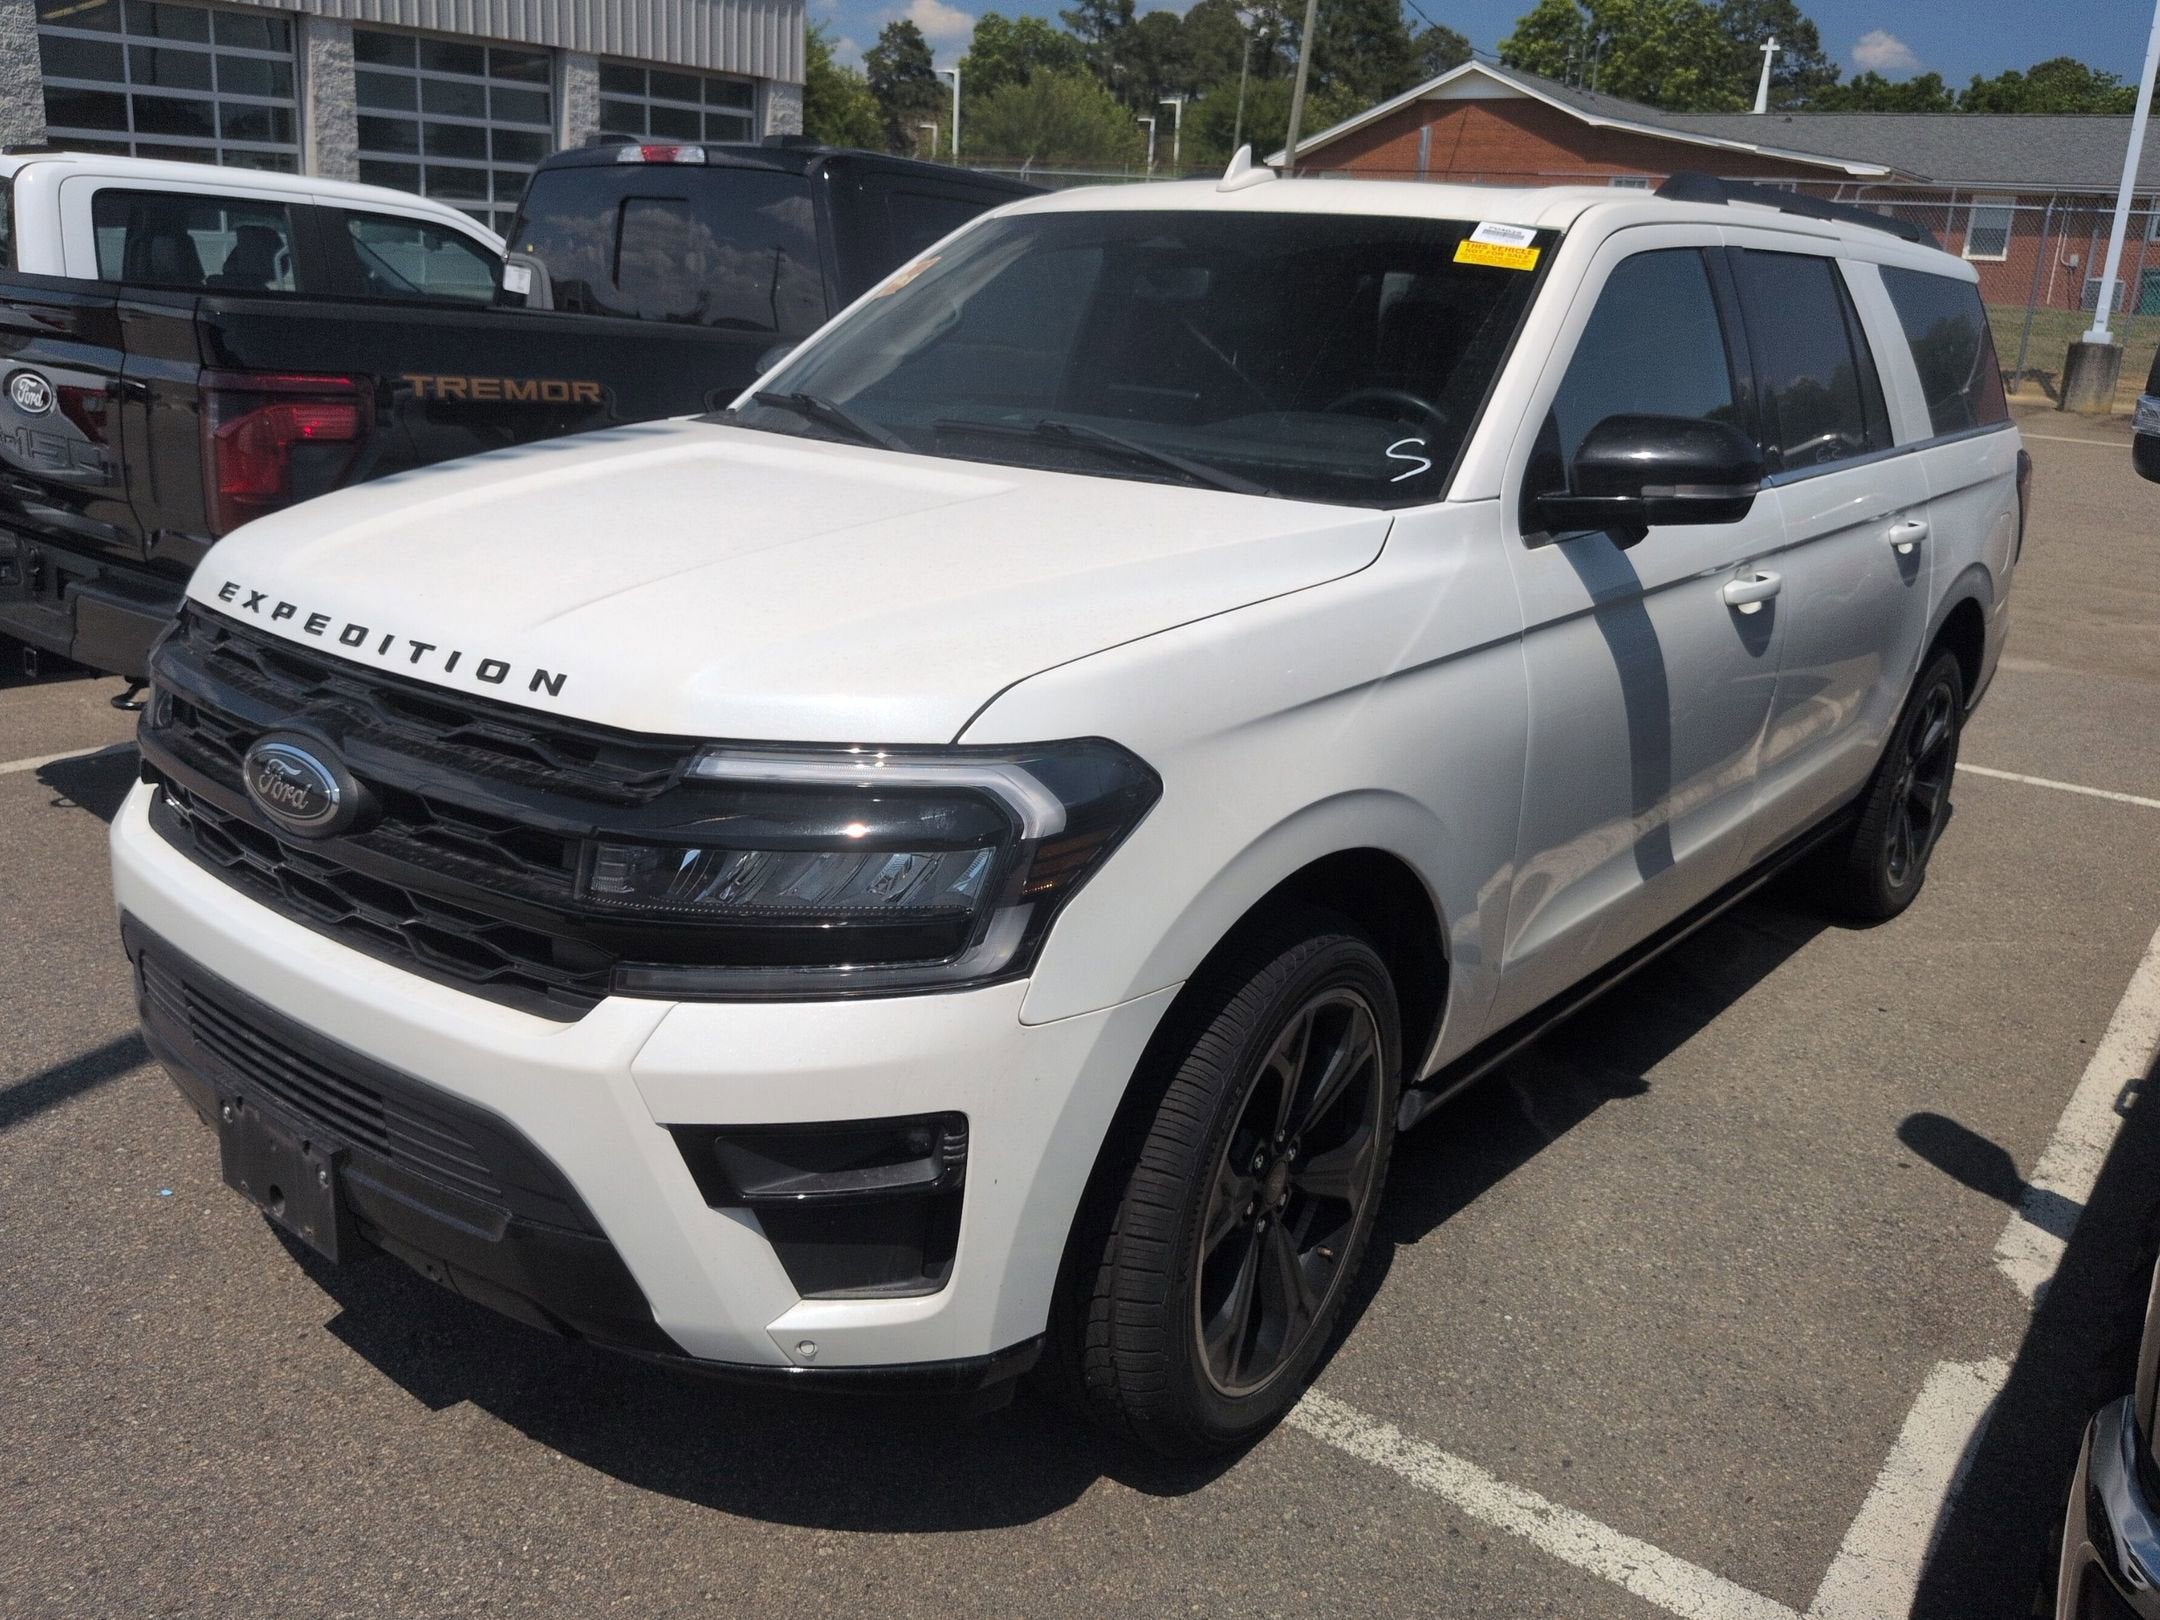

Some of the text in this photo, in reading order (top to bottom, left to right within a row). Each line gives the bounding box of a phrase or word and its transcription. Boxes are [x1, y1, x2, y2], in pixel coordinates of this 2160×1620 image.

[17, 378, 44, 408] Ford
[401, 373, 602, 403] TREMOR
[1385, 437, 1432, 483] S
[218, 580, 568, 697] EXPEDITION
[258, 758, 313, 810] Ford
